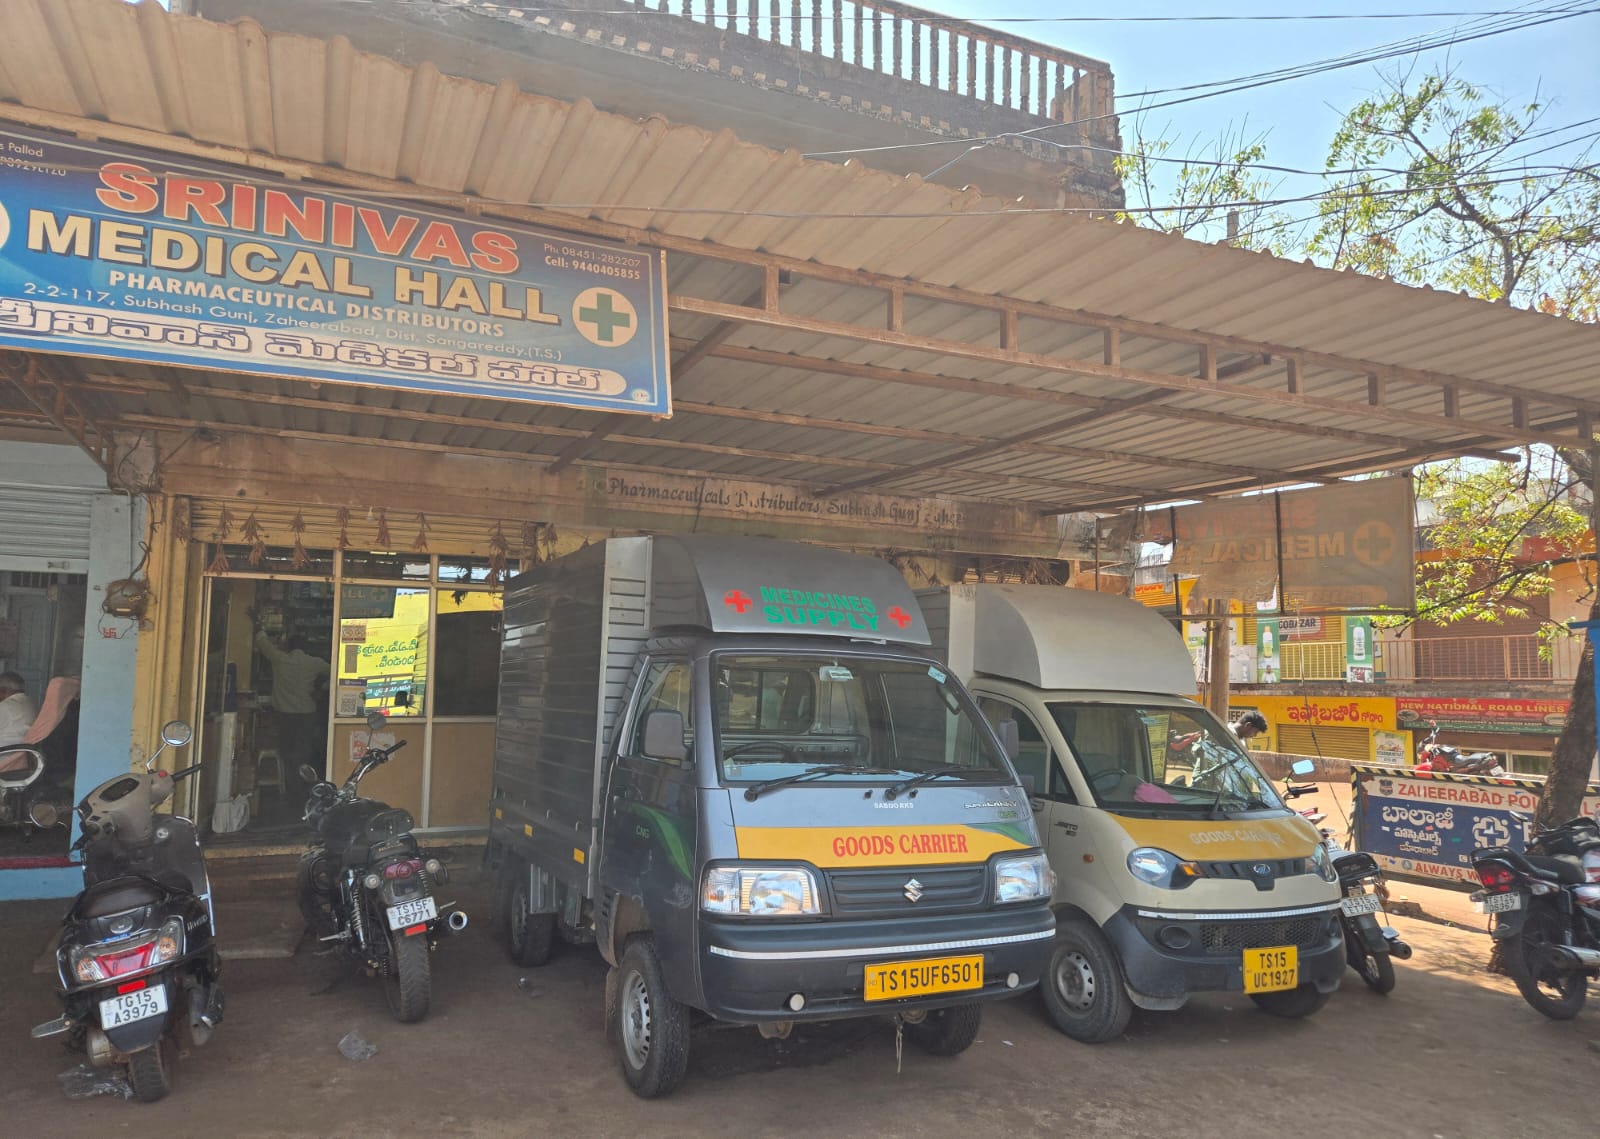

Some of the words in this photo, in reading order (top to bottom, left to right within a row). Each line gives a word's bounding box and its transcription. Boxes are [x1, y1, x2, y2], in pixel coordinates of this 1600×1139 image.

[8, 142, 44, 158] Pallod
[96, 162, 520, 274] SRINIVAS
[27, 208, 373, 299] MEDICAL
[394, 266, 562, 326] HALL
[544, 255, 569, 269] Cell:
[572, 260, 641, 280] 9440405855
[24, 282, 116, 306] 2-2-117,
[123, 294, 203, 316] Subhash
[209, 304, 259, 325] Gunj,
[264, 313, 380, 337] Zaheerabad,
[386, 328, 419, 342] Dist.
[109, 270, 337, 316] PHARMACEUTICAL
[346, 303, 505, 338] DISTRIBUTORS
[486, 358, 602, 393] హాల్
[759, 585, 877, 614] MEDICINES
[763, 605, 880, 632] SUPPLY
[1400, 702, 1425, 710] NEW
[1427, 703, 1486, 711] NATIONAL
[1488, 704, 1523, 712] ROAD
[1526, 705, 1565, 713] LINES
[1382, 806, 1454, 830] బాలాజీ
[832, 835, 895, 858] GOODS
[899, 833, 969, 855] CARRIER
[1188, 831, 1234, 846] GOODS
[1415, 862, 1464, 880] ALWAYS
[396, 899, 429, 916] TS15F
[398, 909, 432, 926] C6771
[1258, 951, 1287, 969] TS15
[877, 960, 982, 993] TS15UF6501
[1253, 968, 1296, 989] UC1927
[116, 989, 152, 1011] TG15
[114, 1001, 159, 1025] A3979
